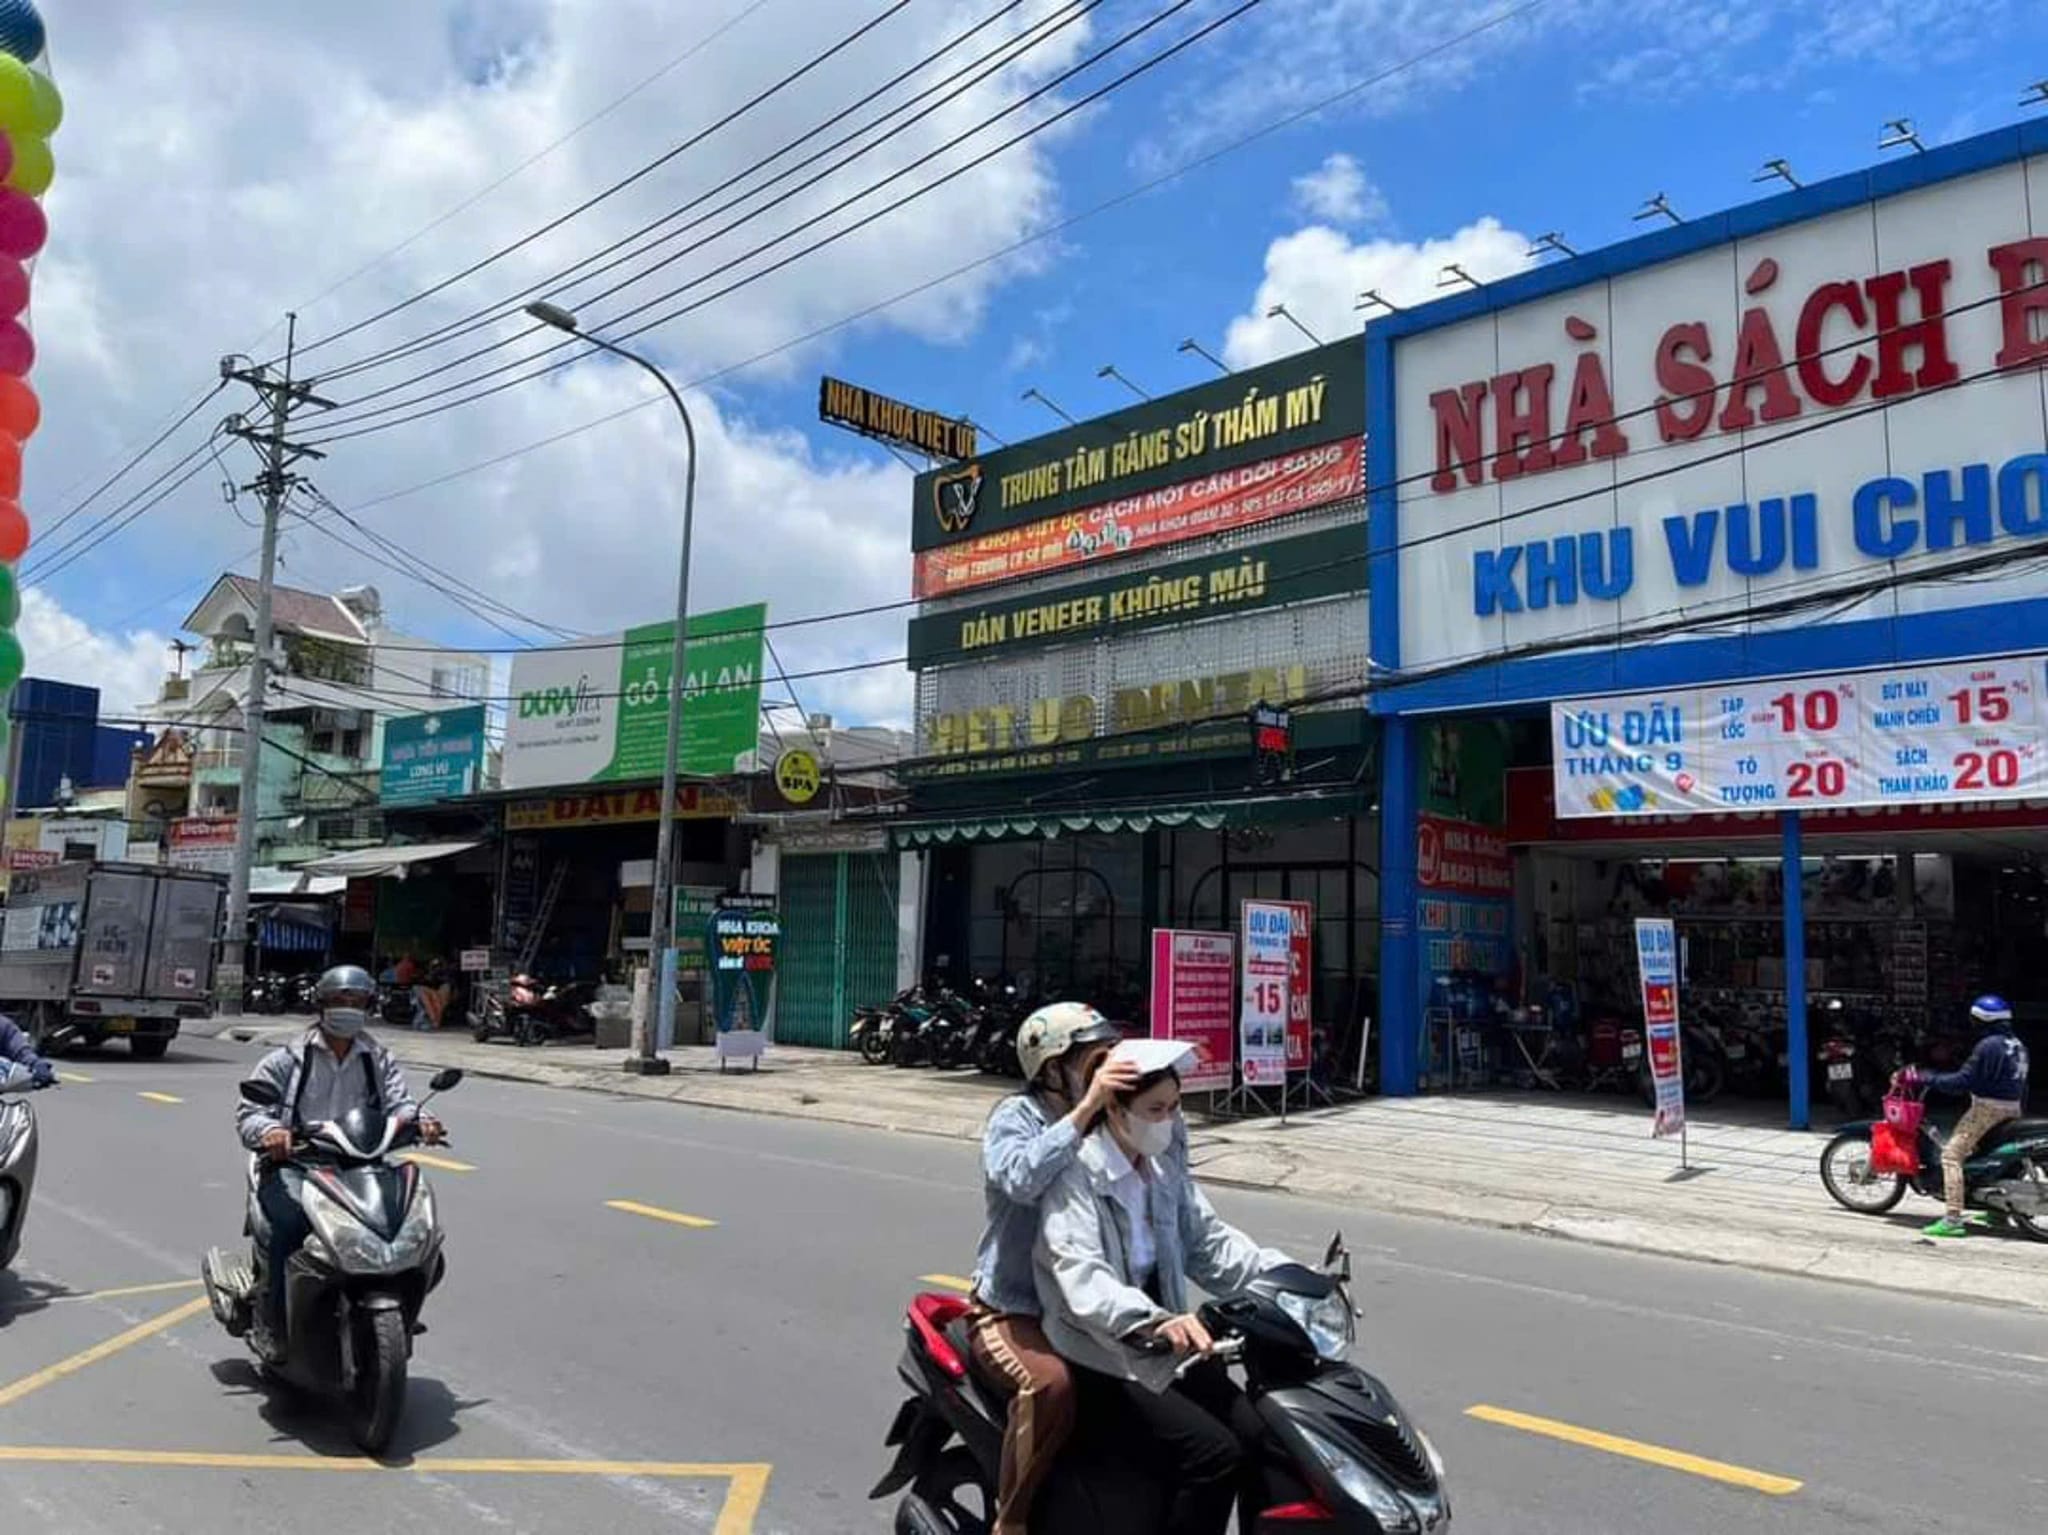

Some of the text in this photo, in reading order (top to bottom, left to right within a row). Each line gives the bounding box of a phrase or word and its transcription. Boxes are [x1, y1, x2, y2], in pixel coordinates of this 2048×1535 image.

[1430, 315, 1628, 492] NHÀ
[1654, 257, 1959, 443] SÁCH
[1001, 460, 1062, 507] TRUNG
[1064, 446, 1105, 492] TÂM
[1112, 431, 1170, 477] RĂNG
[1285, 374, 1325, 429] MỸ
[1473, 527, 1633, 617] KHU
[1663, 492, 1819, 588] VUI
[961, 611, 1006, 649] DÁN
[1012, 596, 1103, 639] VENEER
[1109, 576, 1201, 623] KHÔNG
[715, 661, 753, 695] AN
[1564, 701, 1682, 749] ƯU ĐÃI
[1564, 751, 1683, 776] THÁNG 9
